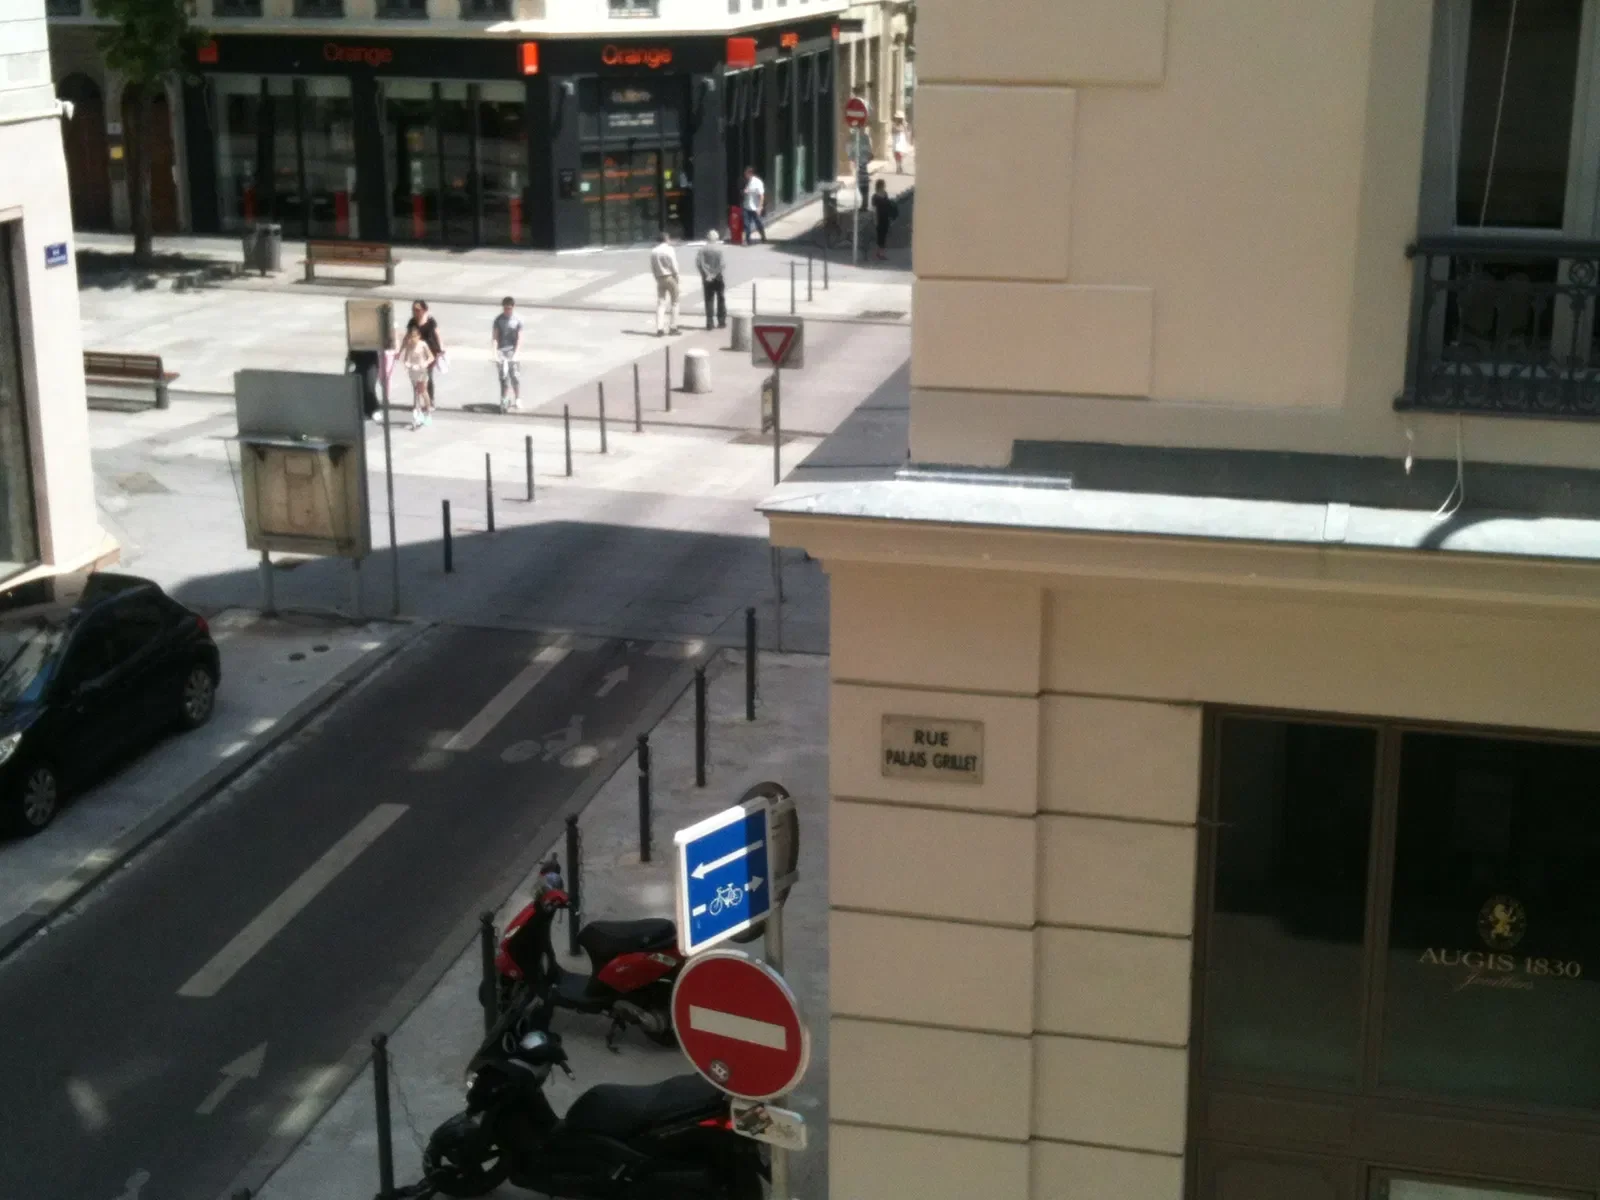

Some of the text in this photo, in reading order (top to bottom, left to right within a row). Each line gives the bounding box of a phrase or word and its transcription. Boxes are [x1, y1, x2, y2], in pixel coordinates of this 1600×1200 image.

[323, 43, 393, 67] Orange
[602, 44, 672, 68] Orange
[914, 730, 949, 747] RUE
[885, 750, 978, 772] PALAIS GRILLET
[1418, 947, 1581, 979] AUGIS 1830
